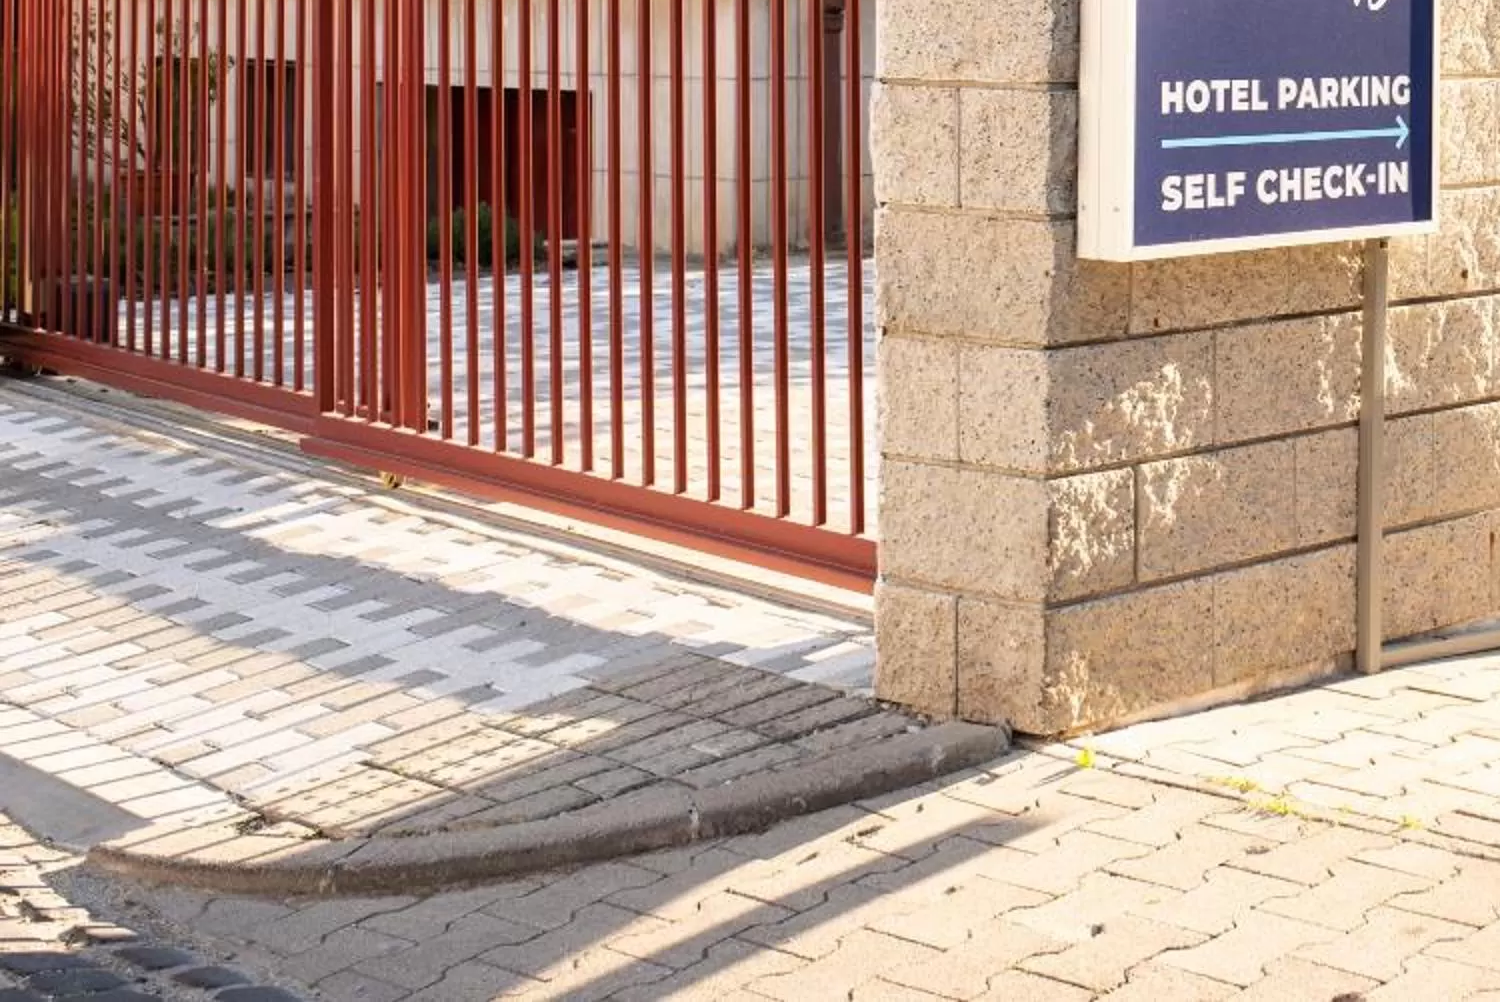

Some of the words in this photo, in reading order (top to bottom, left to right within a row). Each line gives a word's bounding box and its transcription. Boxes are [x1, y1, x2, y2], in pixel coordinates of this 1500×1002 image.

[1160, 79, 1268, 114] HOTEL
[1278, 74, 1411, 110] PARKING
[1161, 173, 1245, 211] SELF
[1255, 161, 1409, 203] CHECK-IN
